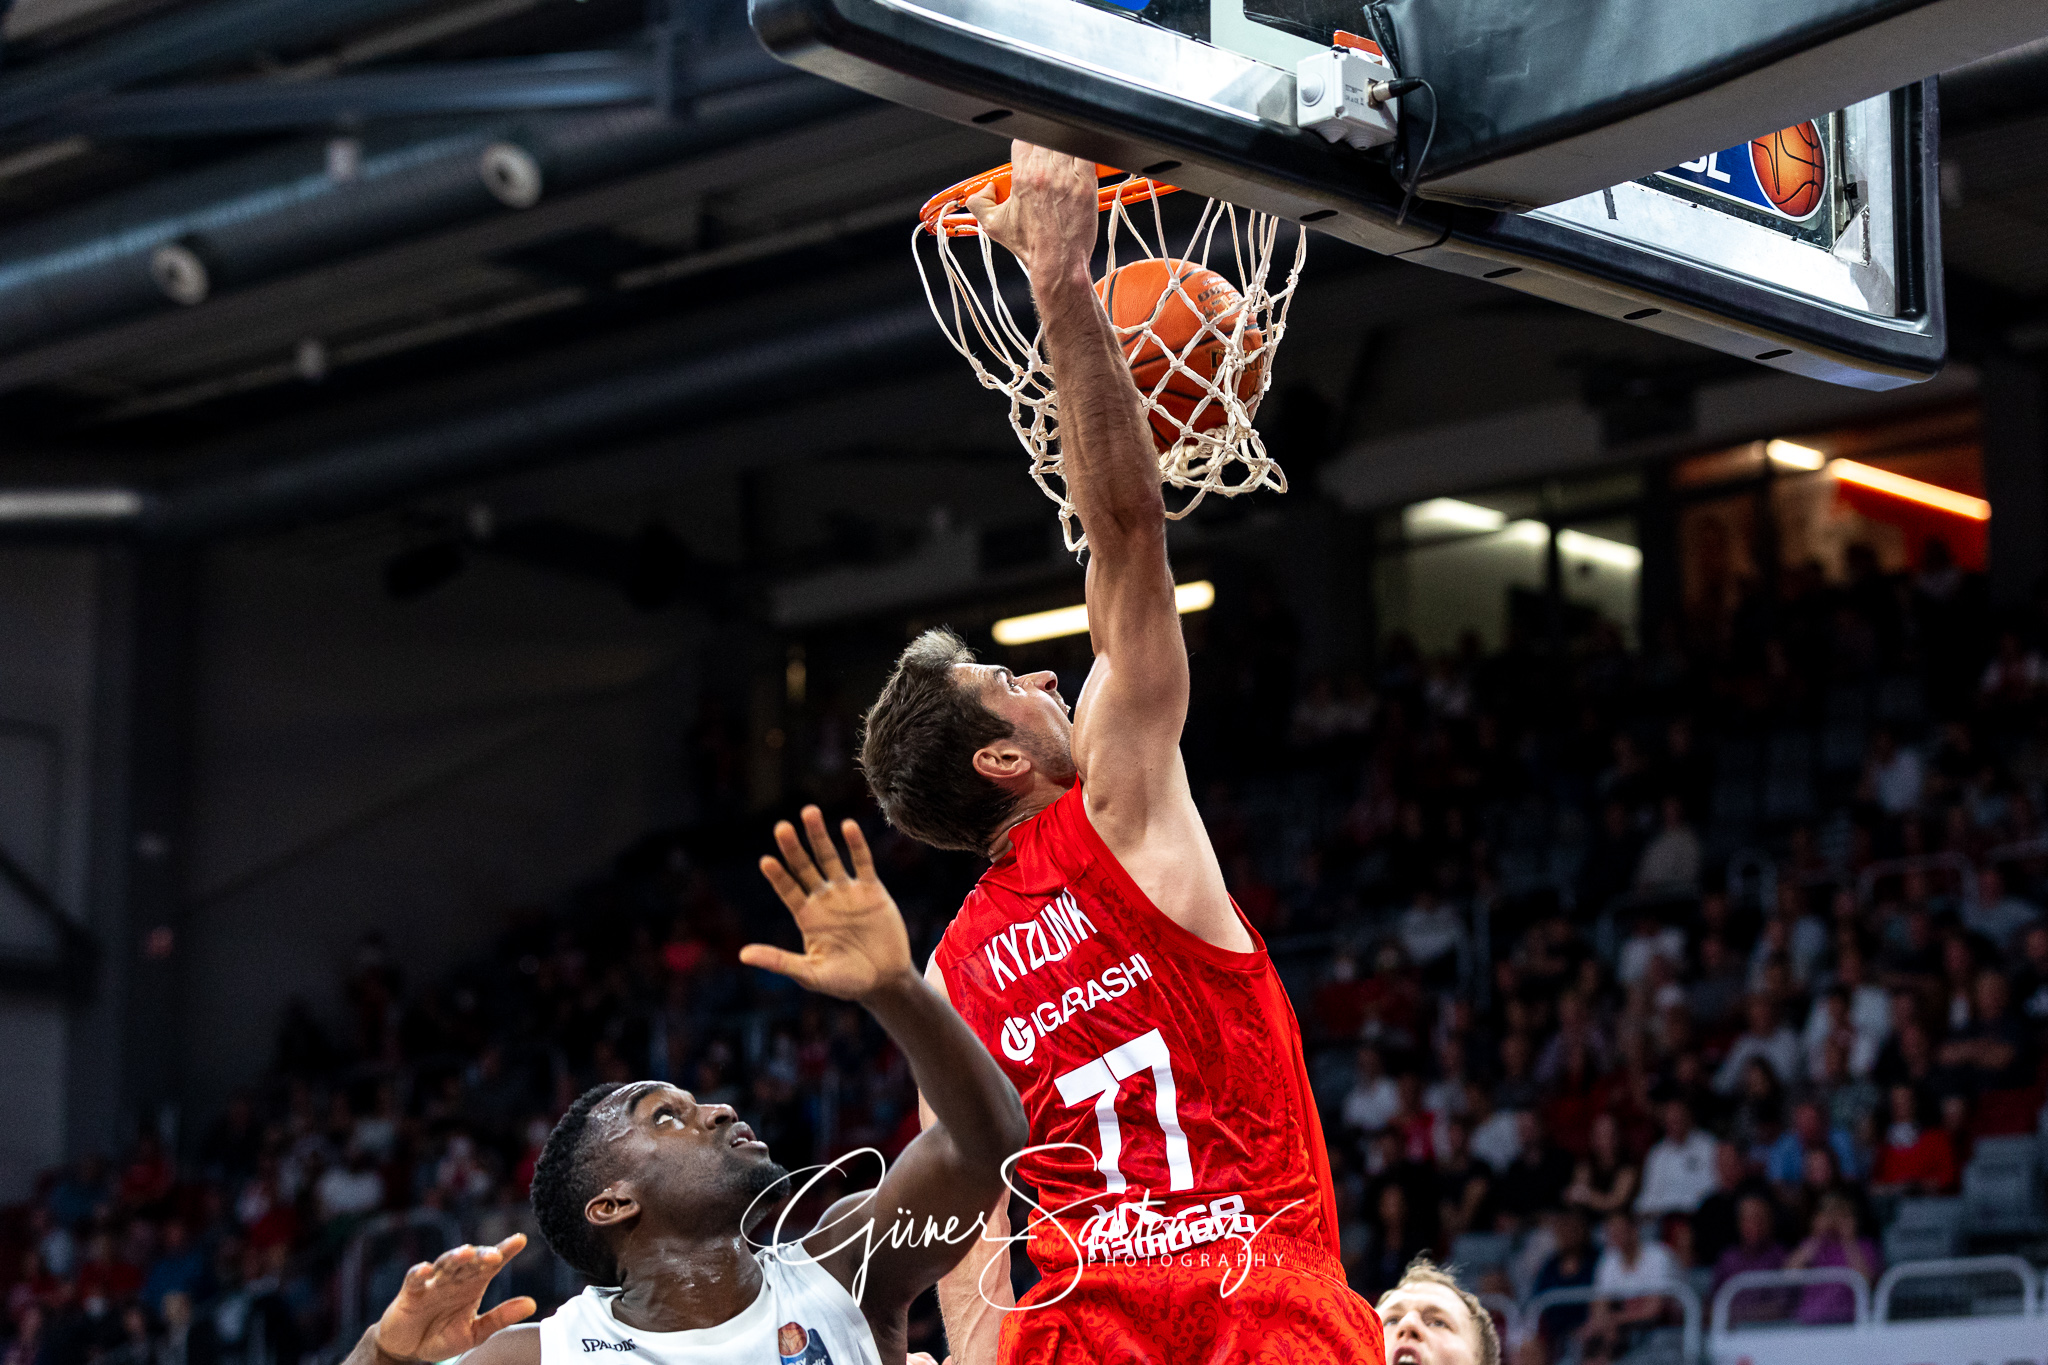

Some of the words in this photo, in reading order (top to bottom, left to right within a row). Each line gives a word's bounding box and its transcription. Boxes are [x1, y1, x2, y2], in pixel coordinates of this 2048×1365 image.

[983, 886, 1099, 992] KYZLINK
[1030, 952, 1153, 1038] IGARASHI
[1053, 1026, 1195, 1195] 77
[581, 1338, 638, 1353] SPALDIN
